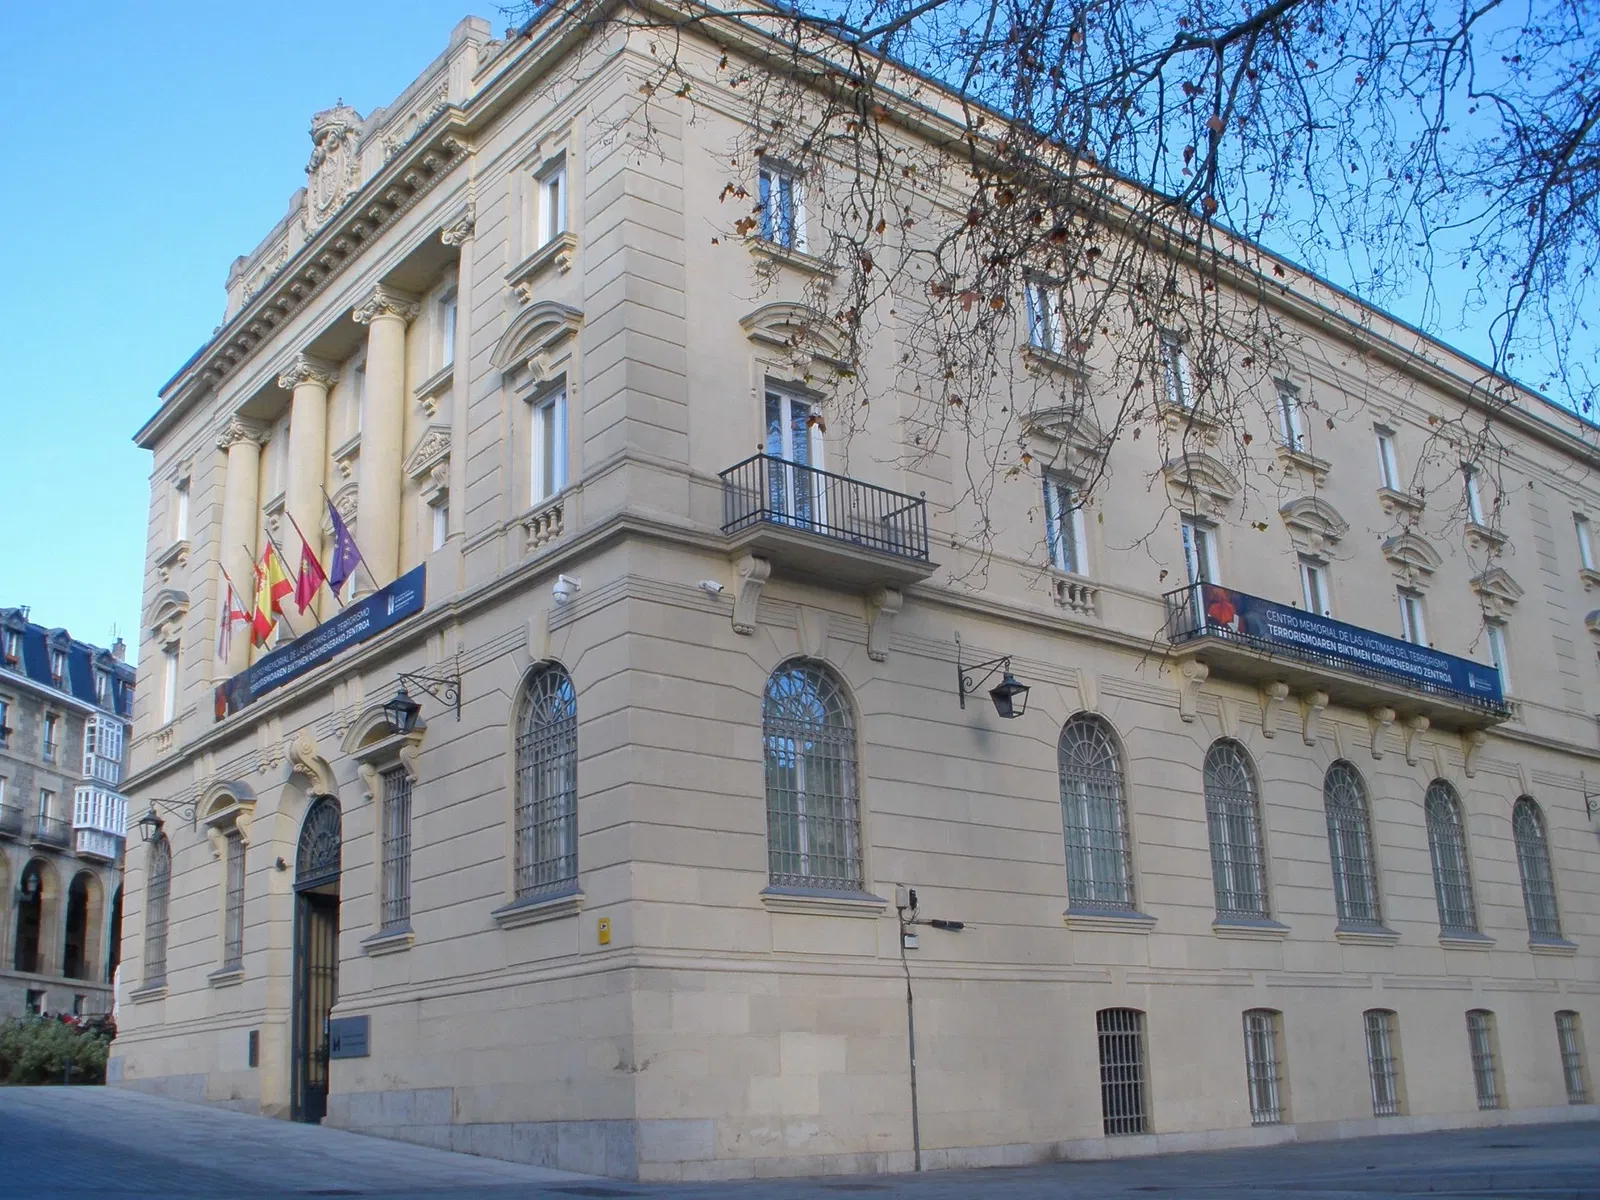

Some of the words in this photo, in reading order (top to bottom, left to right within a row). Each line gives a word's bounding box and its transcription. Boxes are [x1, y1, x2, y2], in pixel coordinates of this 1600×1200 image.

[337, 607, 370, 632] TERRORISMO
[346, 619, 370, 640] ZENTROA
[1266, 609, 1298, 627] CENTRO
[1299, 618, 1338, 639] MEMORIAL
[1338, 630, 1349, 641] DE
[1349, 633, 1363, 646] LAS
[1363, 636, 1395, 655] VÍCTIMAS
[1395, 647, 1409, 659] DEL
[1409, 650, 1449, 670] TERRORISMO
[1267, 623, 1337, 651] TERRORISMOAREN
[1337, 642, 1371, 661] BIKTIMEN
[1371, 653, 1423, 675] OROIMENERAKO
[1423, 667, 1453, 684] ZENTROA
